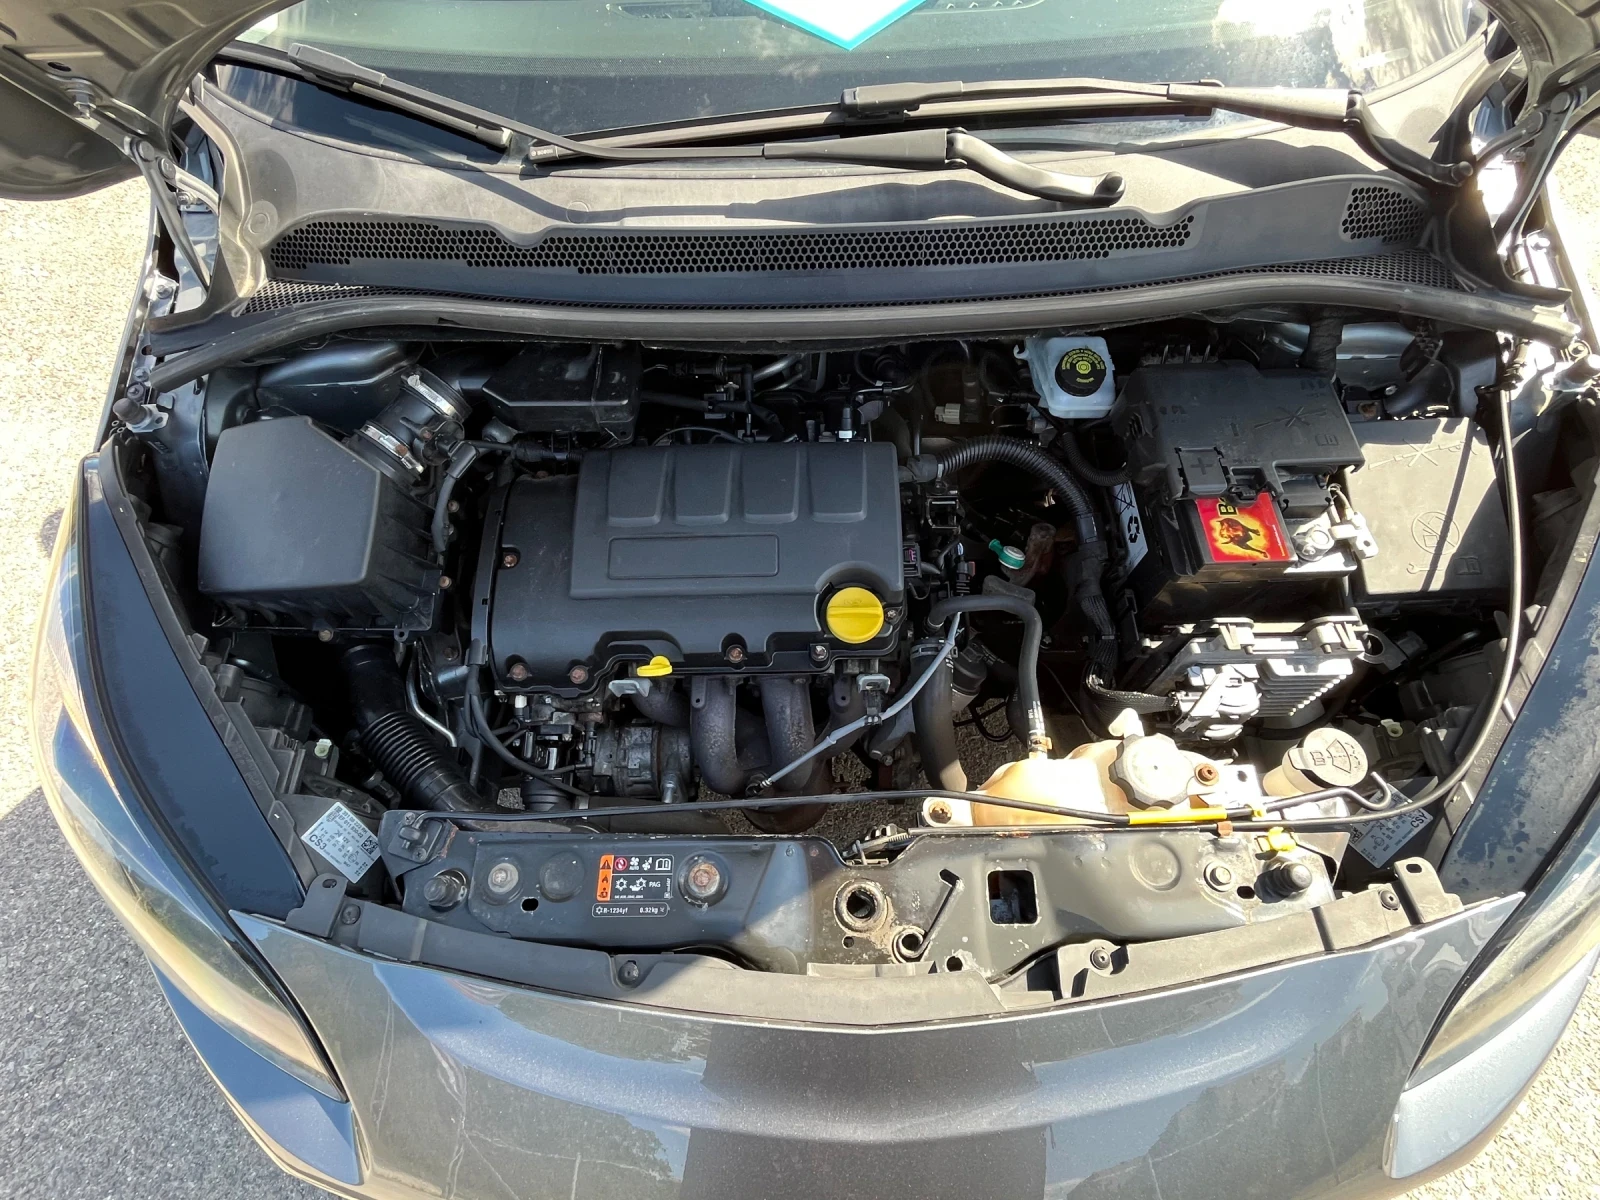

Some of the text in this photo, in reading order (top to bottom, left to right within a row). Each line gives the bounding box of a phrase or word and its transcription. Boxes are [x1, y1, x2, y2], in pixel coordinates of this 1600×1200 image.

[1410, 811, 1428, 828] CSY
[309, 834, 328, 850] CS3
[603, 906, 628, 914] R-1234yf
